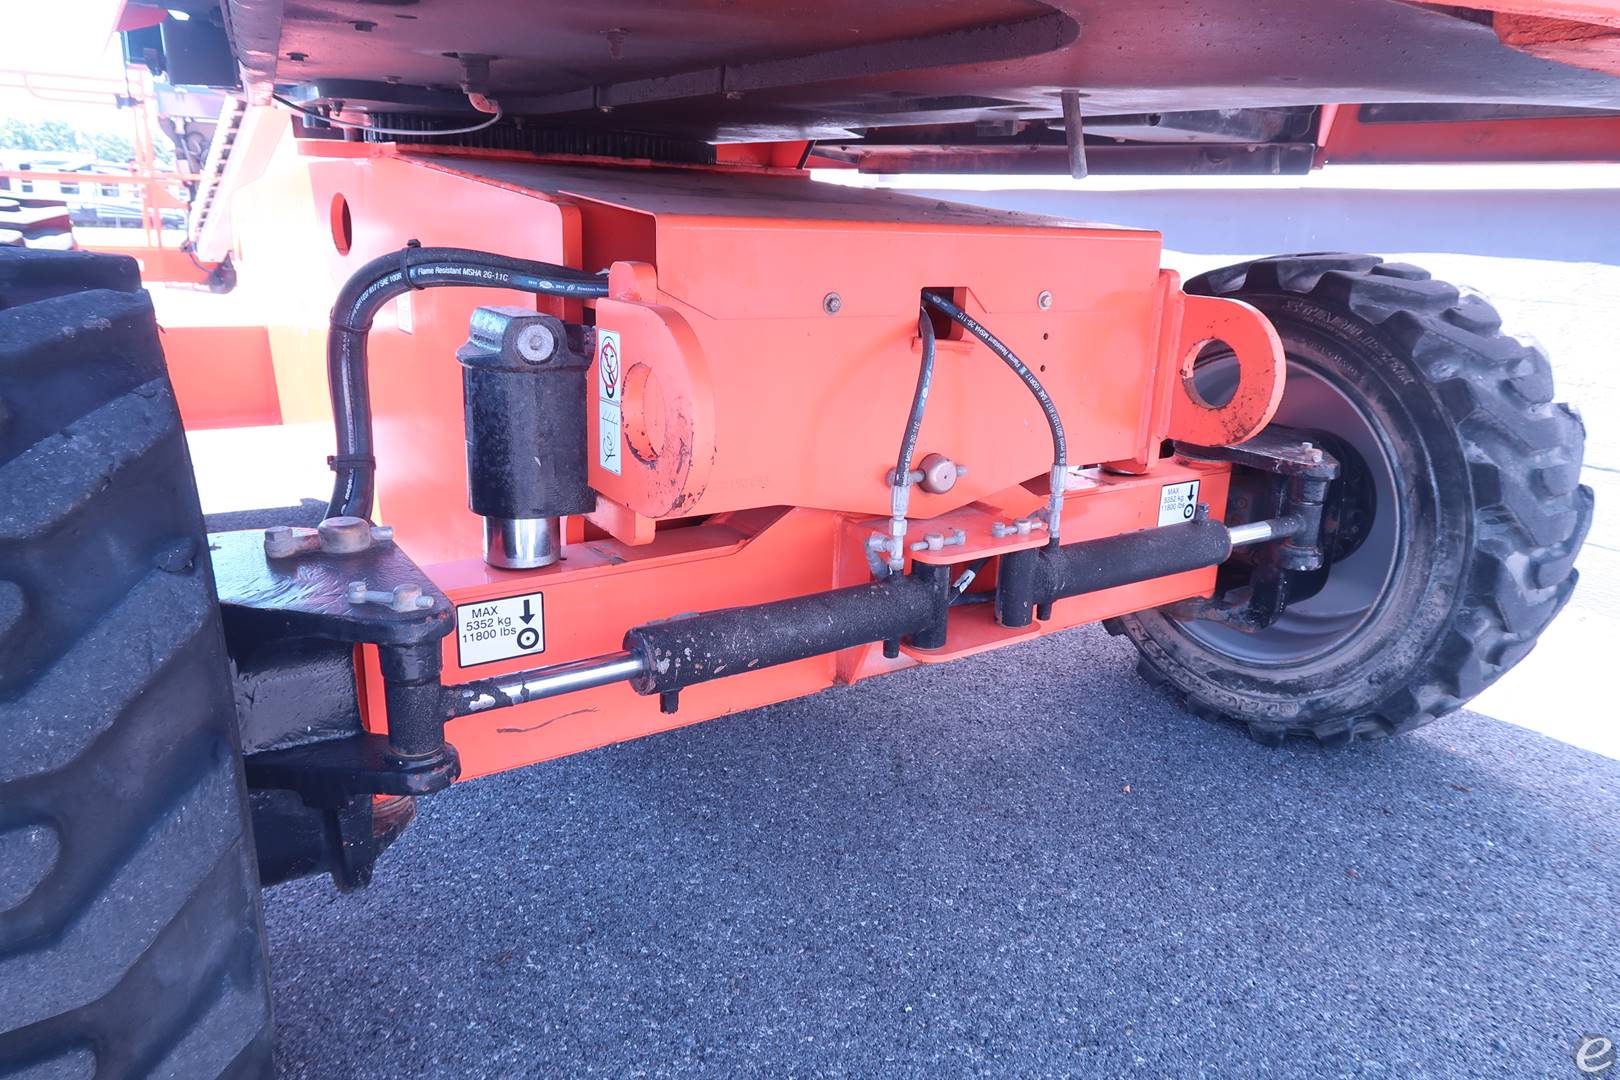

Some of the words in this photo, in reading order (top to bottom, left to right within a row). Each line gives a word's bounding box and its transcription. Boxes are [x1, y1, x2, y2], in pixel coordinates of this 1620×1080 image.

[417, 267, 434, 275] Flame
[435, 266, 461, 275] Resistant
[462, 267, 481, 277] MSHA
[483, 270, 509, 281] 2G-11C
[957, 312, 976, 328] 2G-11C
[974, 325, 990, 339] MSHA
[988, 336, 1009, 356] Resistant
[1007, 353, 1021, 368] Flame
[1039, 390, 1047, 400] SAE
[1163, 495, 1177, 504] 5352
[1161, 503, 1176, 512] 11800
[472, 605, 499, 619] MAX
[466, 618, 494, 631] 5352
[497, 616, 512, 627] kg
[462, 629, 497, 643] 11800
[500, 627, 517, 636] lbs
